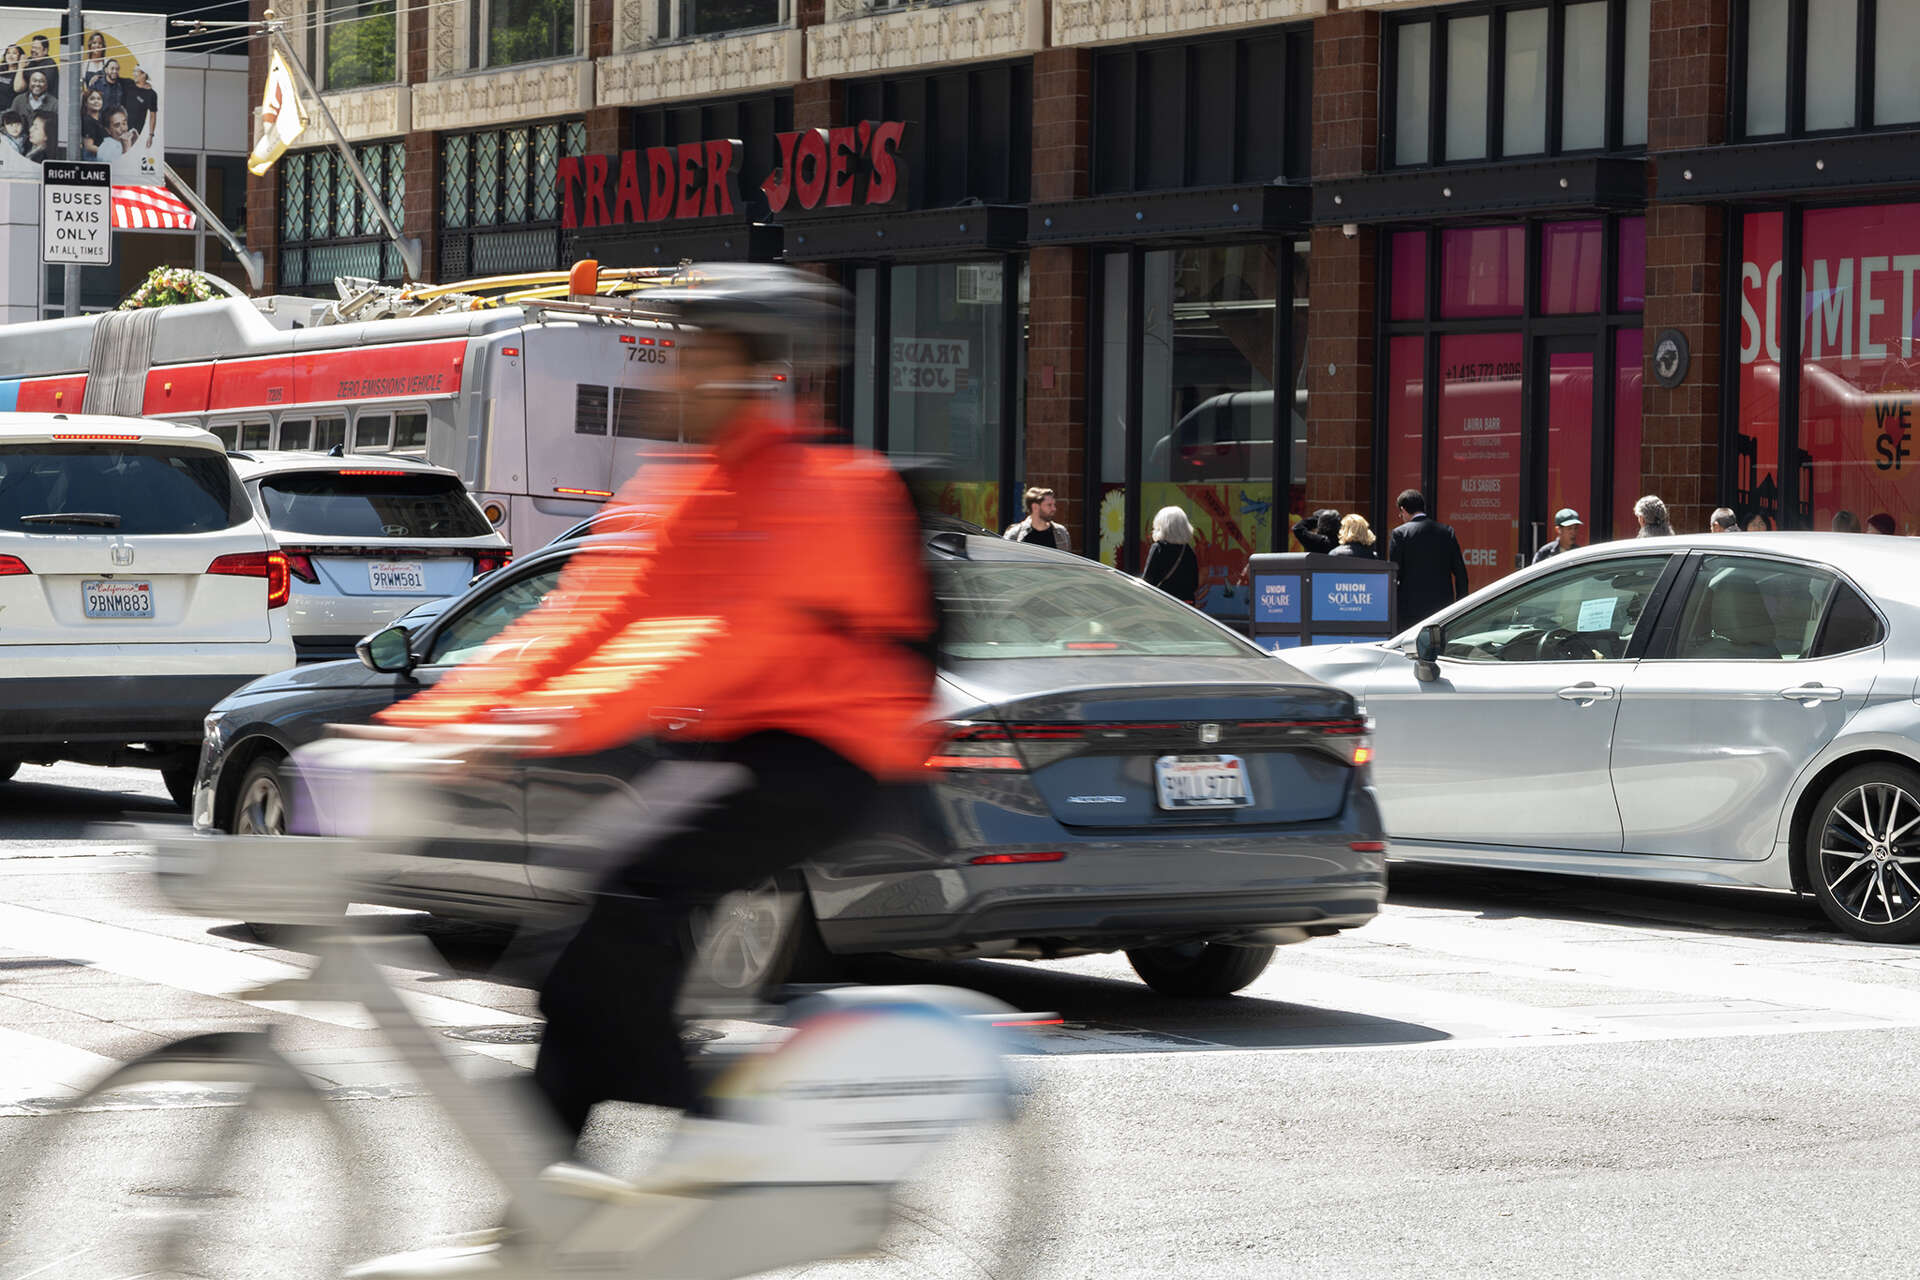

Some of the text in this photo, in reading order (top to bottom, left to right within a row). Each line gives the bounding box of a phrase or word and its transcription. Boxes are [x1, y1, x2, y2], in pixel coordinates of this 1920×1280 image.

[48, 169, 106, 181] RIGHT LANE
[555, 120, 905, 229] TRADER JOE'S
[52, 192, 102, 205] BUSES
[55, 210, 99, 223] TAXIS
[56, 228, 97, 241] ONLY
[49, 245, 104, 256] AT ALL TIMES
[628, 347, 666, 364] 7205
[337, 374, 443, 397] ZERO EMISSIONS VEHICLE
[1875, 399, 1912, 429] WE
[1876, 433, 1912, 470] SF
[1463, 549, 1497, 566] CBRE
[373, 573, 422, 587] 9RWM581
[1335, 583, 1366, 592] UNION
[89, 594, 149, 611] 9BNM883
[1261, 594, 1290, 608] SQUARE
[1328, 592, 1373, 606] SQUARE
